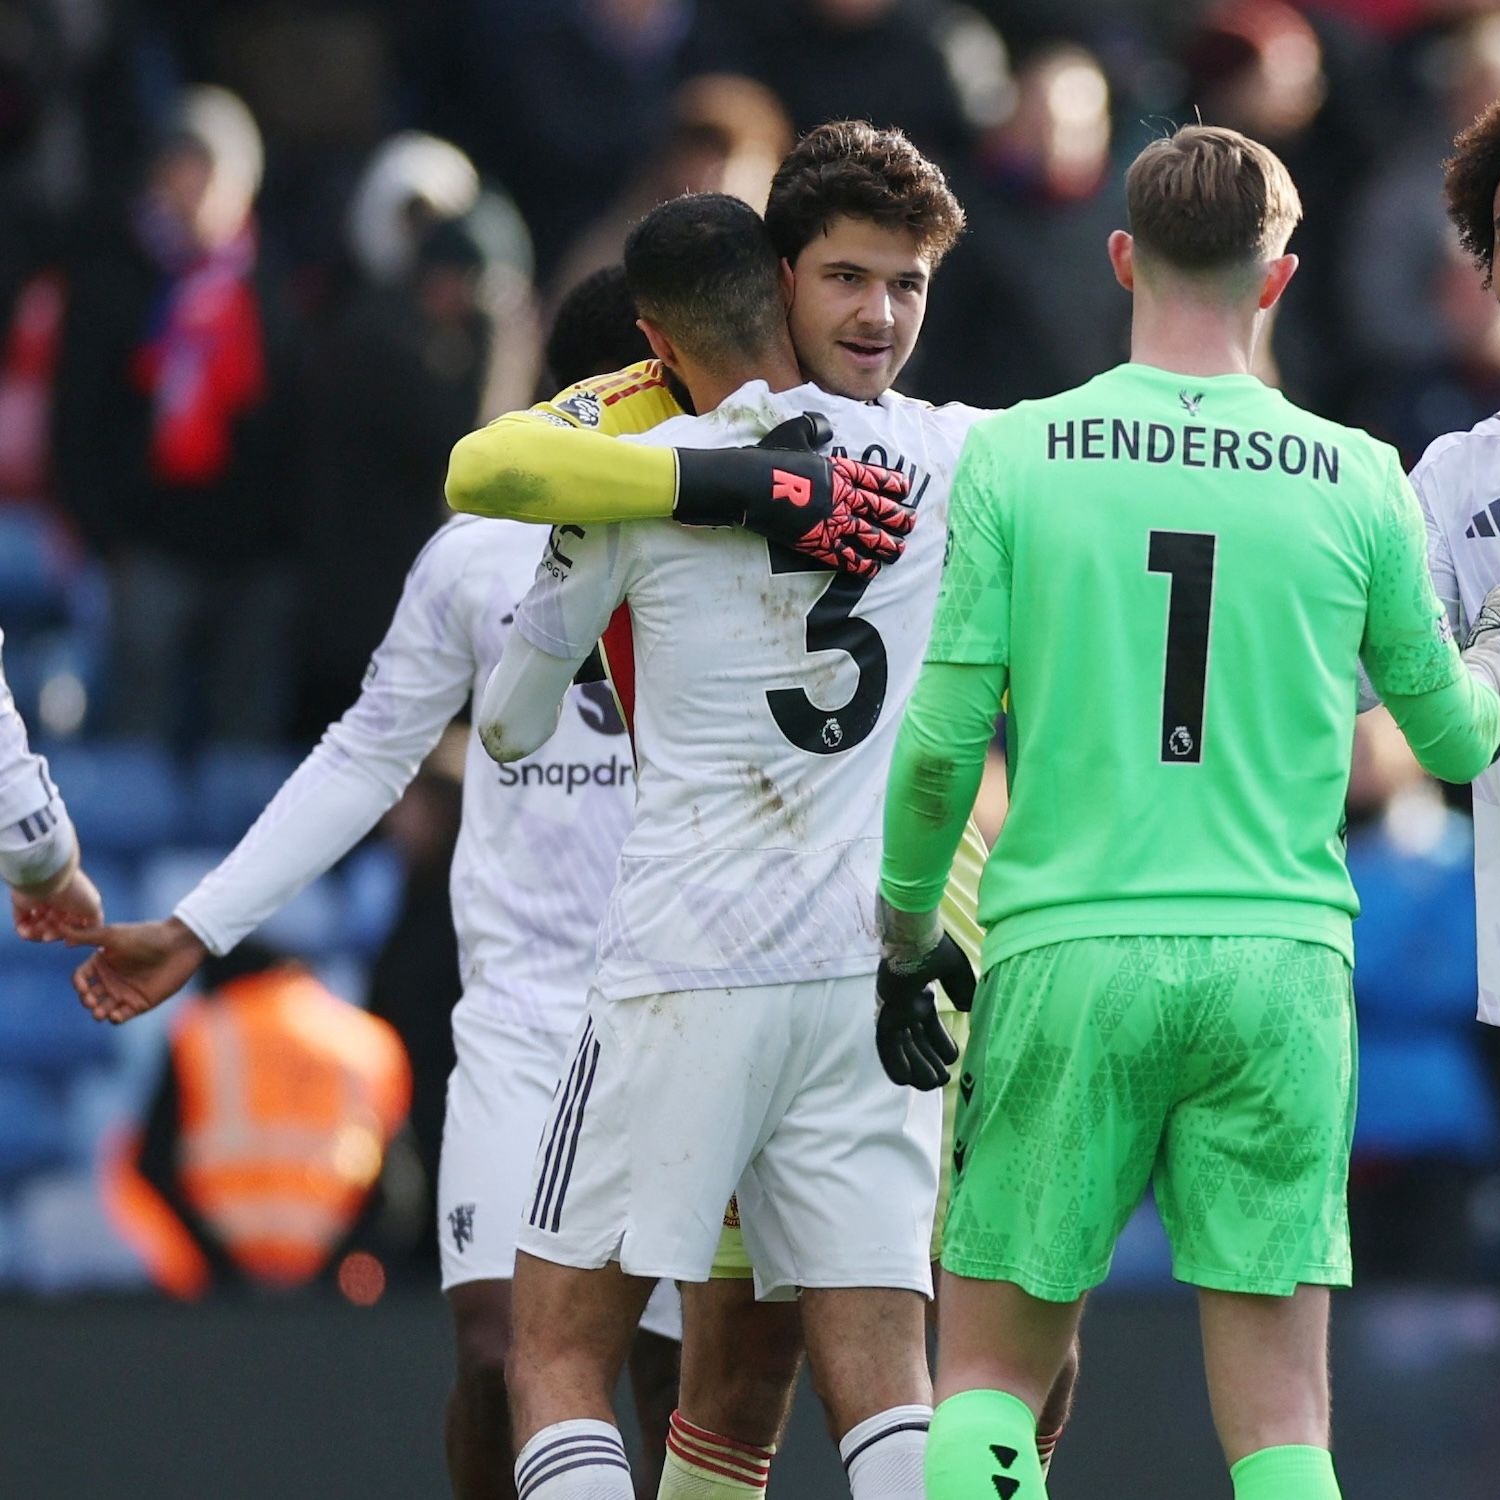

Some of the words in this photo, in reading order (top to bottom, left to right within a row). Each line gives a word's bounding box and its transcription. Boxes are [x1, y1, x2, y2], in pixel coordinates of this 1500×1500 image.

[1047, 418, 1339, 485] HENDERSON
[765, 535, 889, 755] 3
[1147, 530, 1216, 763] 1
